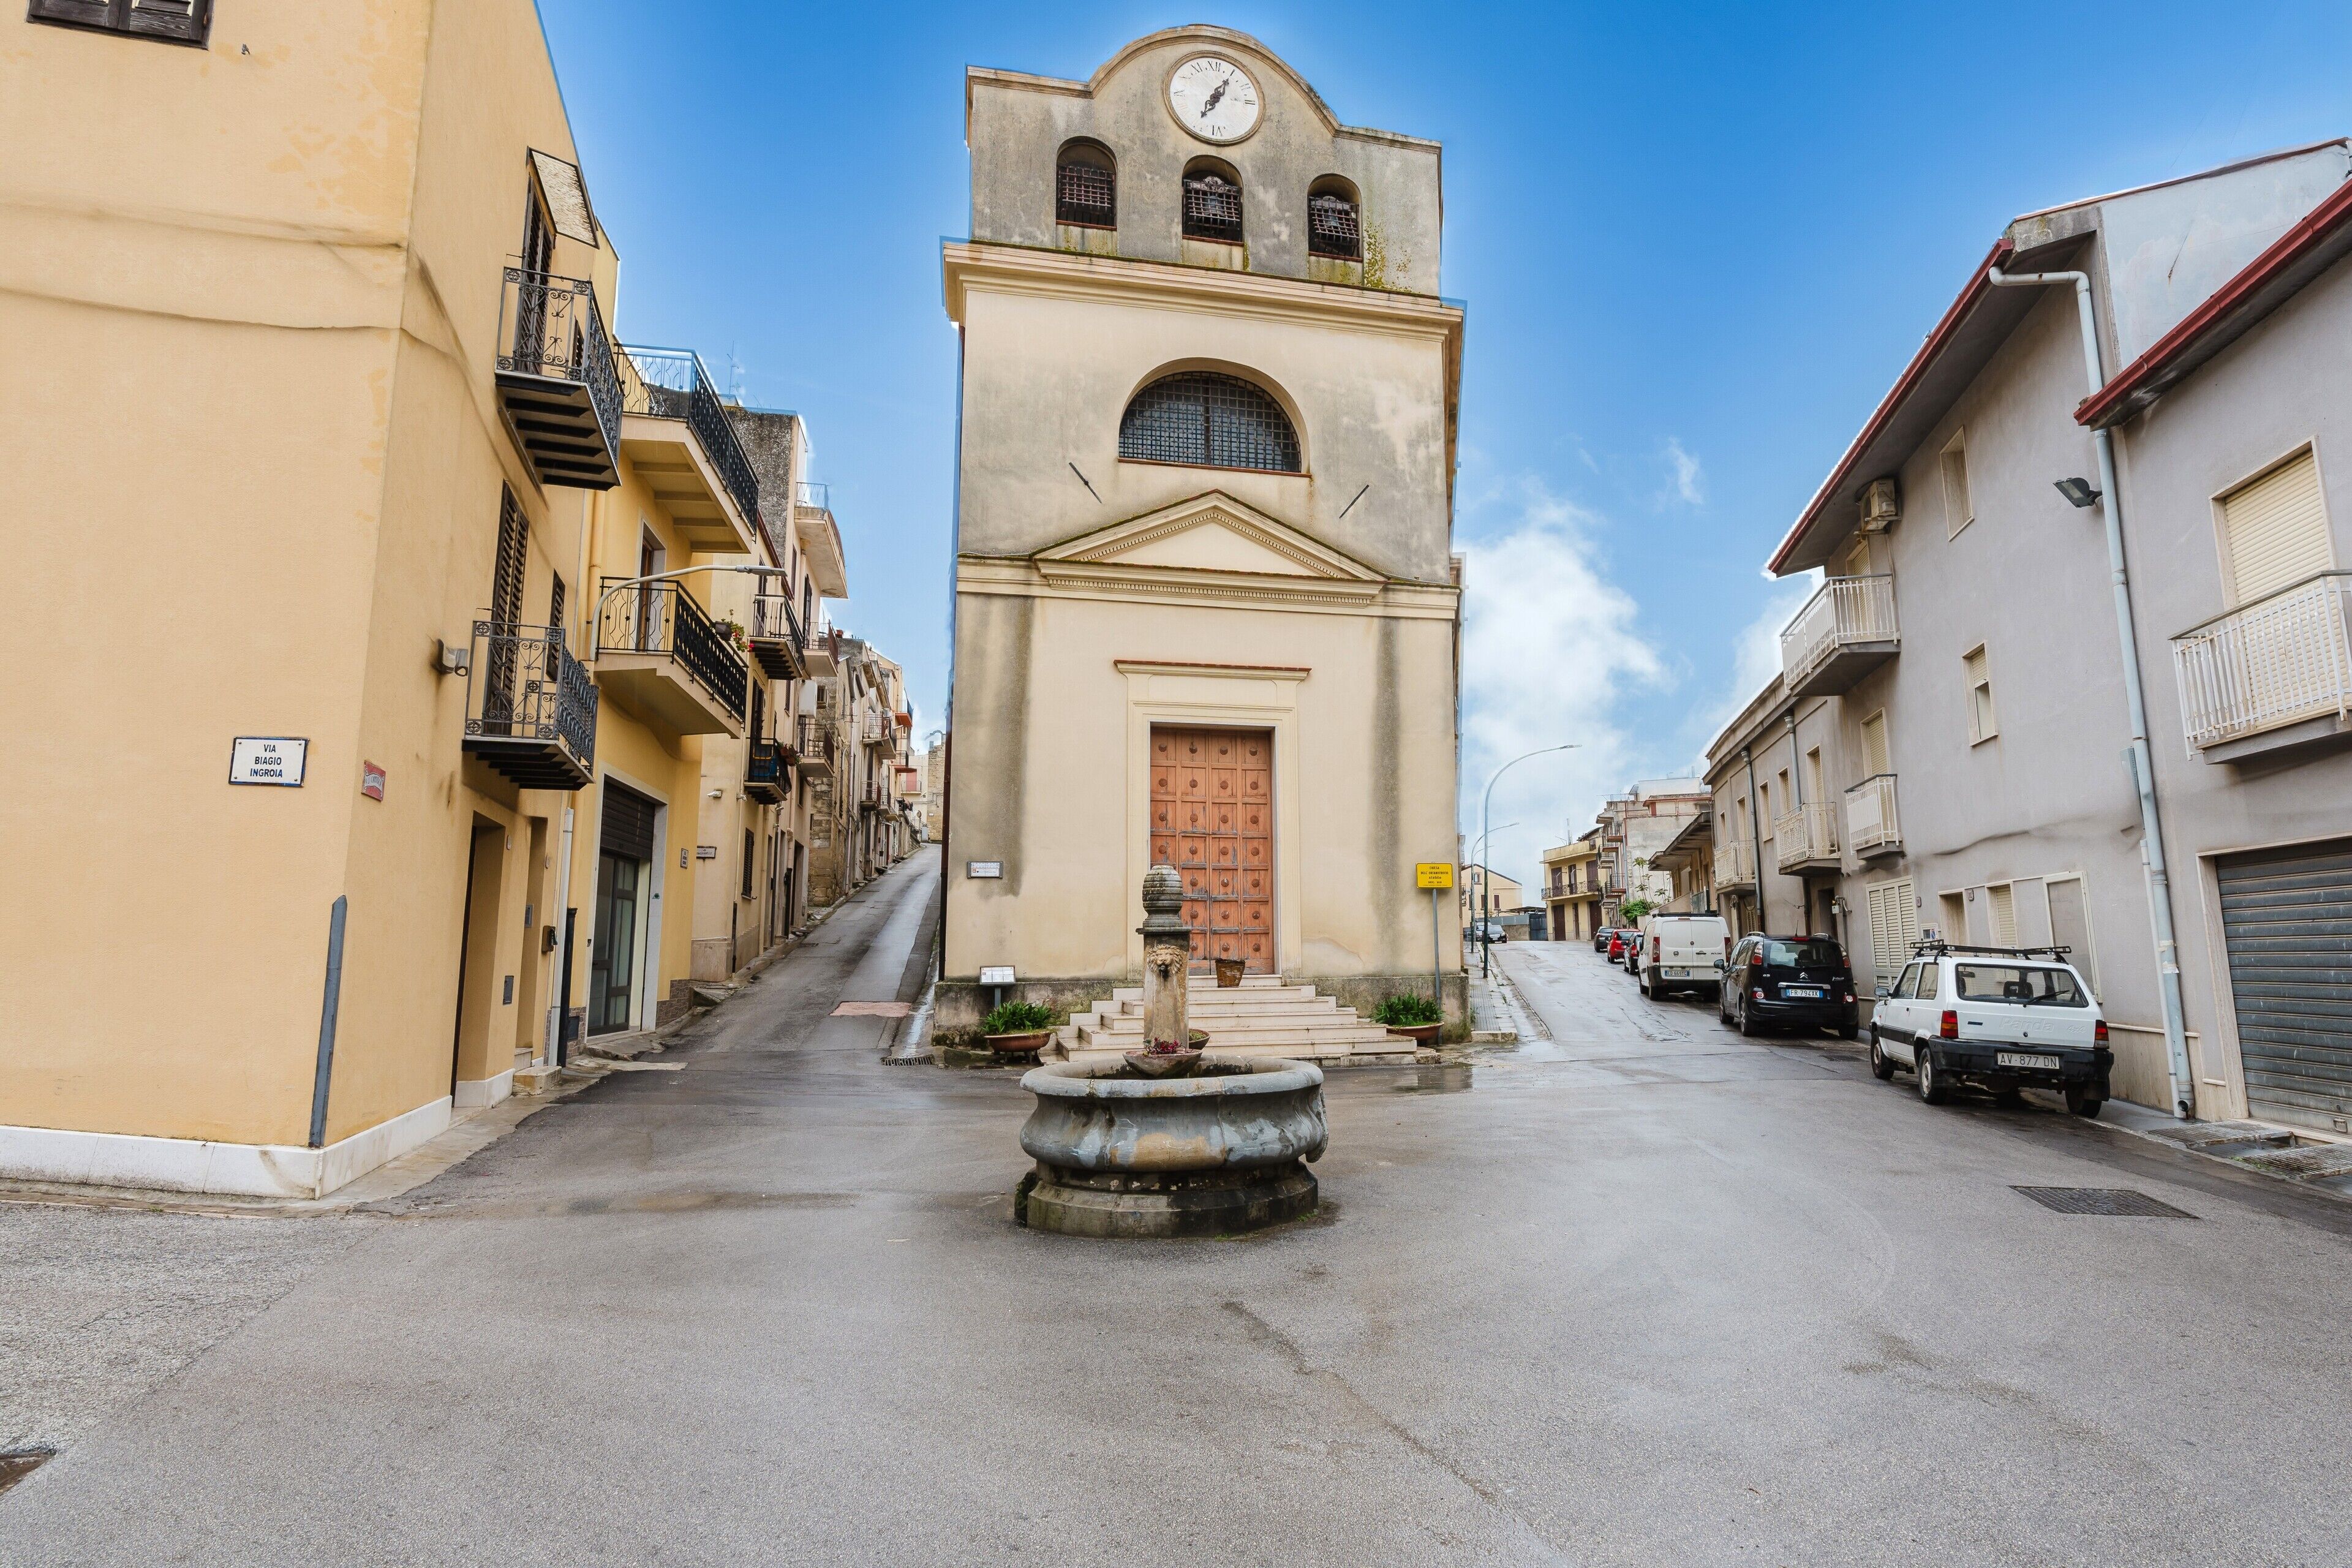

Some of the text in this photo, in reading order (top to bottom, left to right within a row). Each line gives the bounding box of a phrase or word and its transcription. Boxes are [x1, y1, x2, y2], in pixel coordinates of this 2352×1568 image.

[264, 744, 276, 753] VIA
[254, 756, 282, 766] BIAGIO
[250, 768, 283, 778] INGROIA
[1999, 1016, 2054, 1033] Panda
[2044, 1057, 2057, 1068] DN
